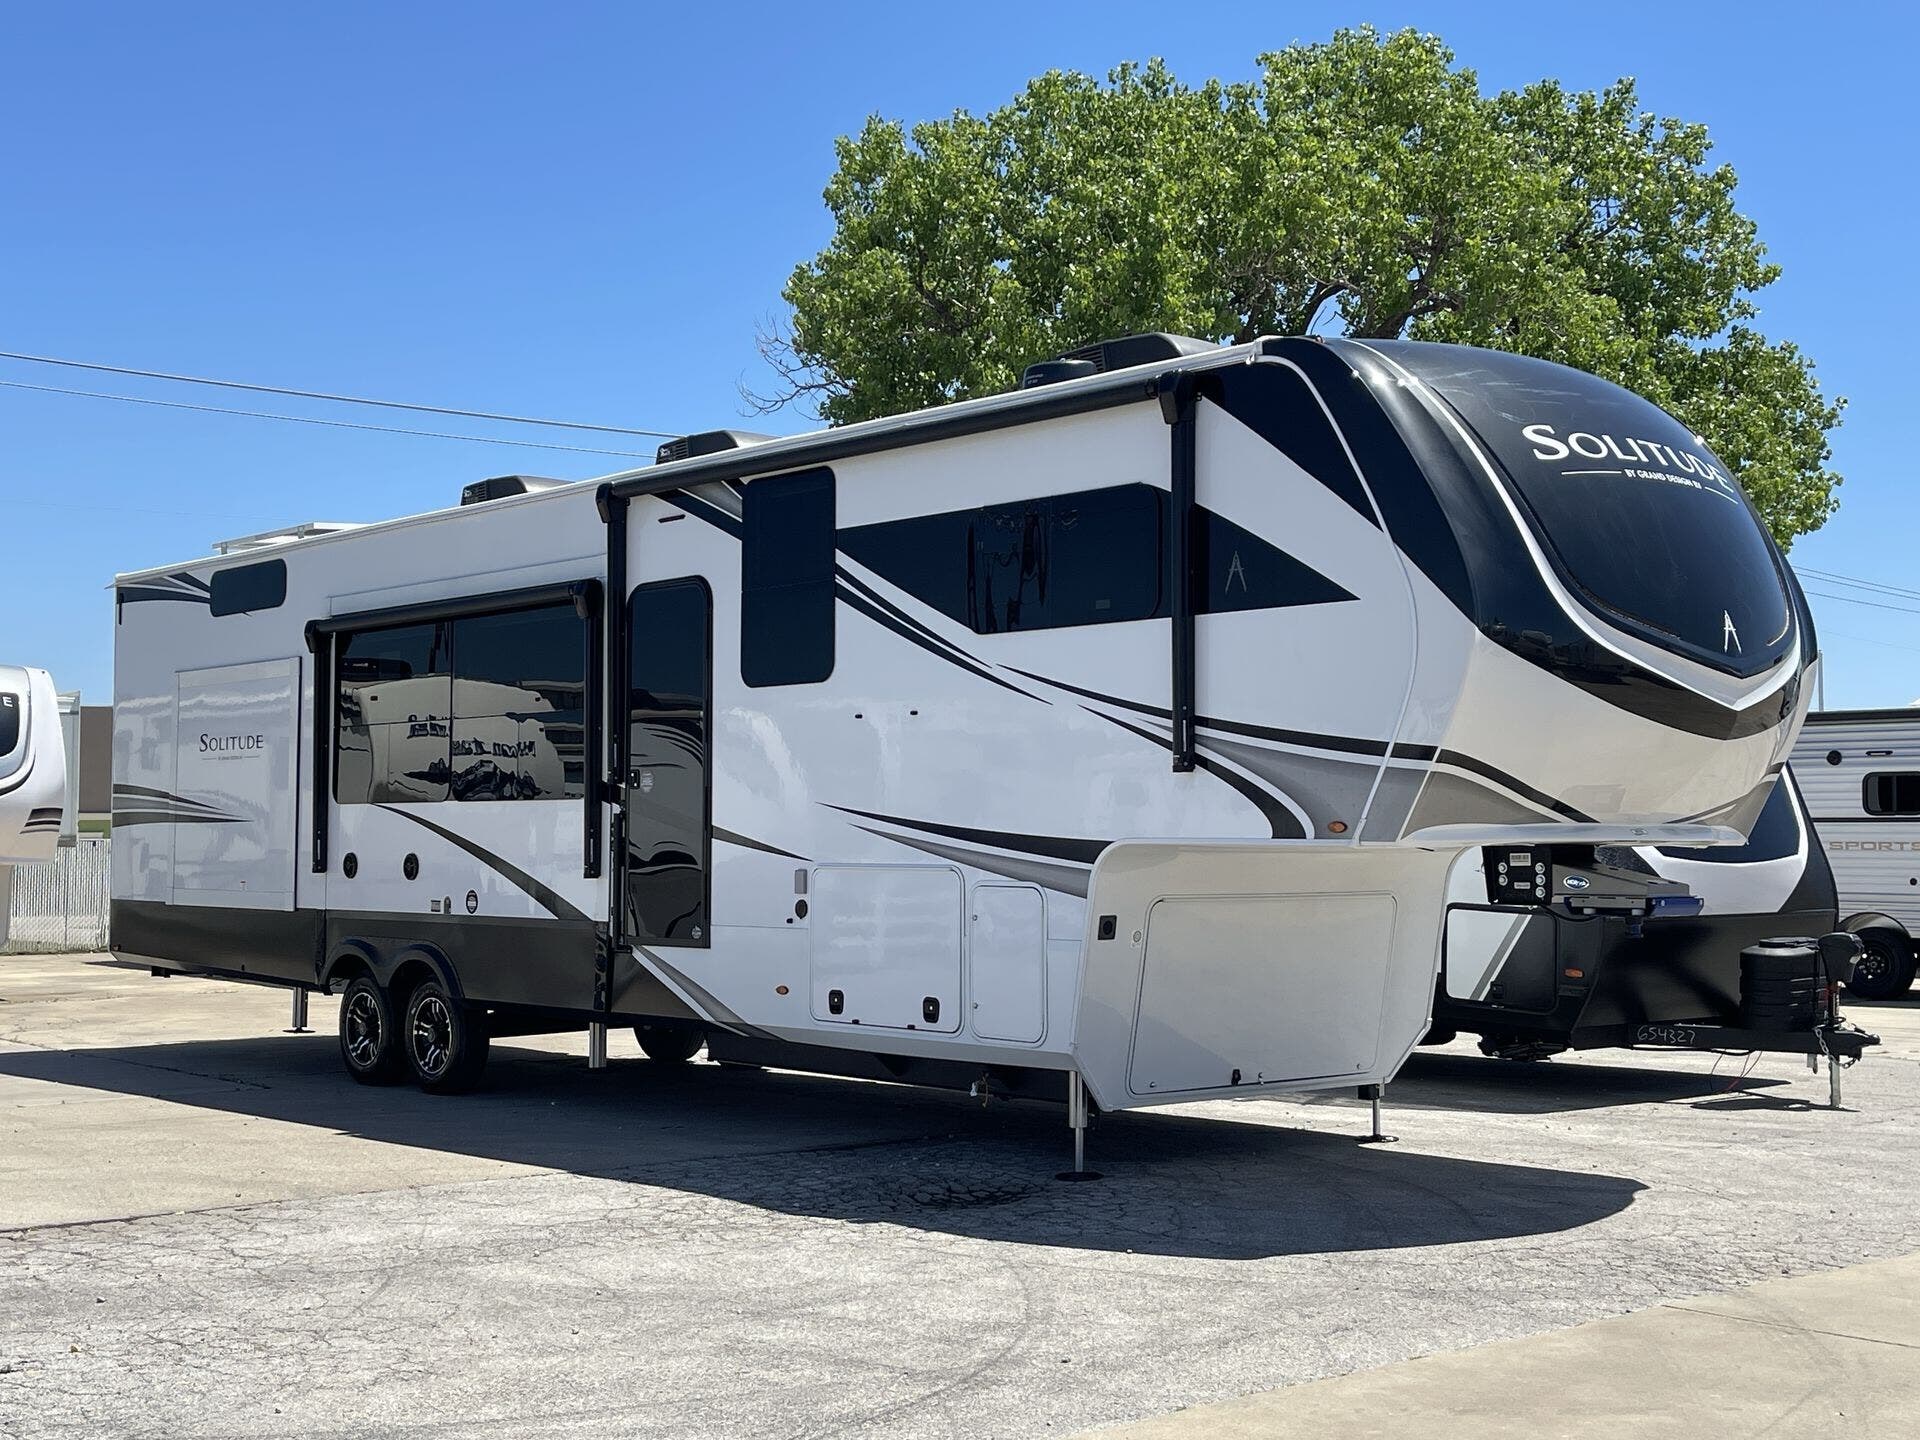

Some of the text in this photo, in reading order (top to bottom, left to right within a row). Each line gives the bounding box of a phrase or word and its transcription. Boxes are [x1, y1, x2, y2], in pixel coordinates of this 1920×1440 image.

[1521, 424, 1735, 493] SOLITUDE
[1624, 468, 1636, 478] BY
[1636, 469, 1667, 481] GRAND
[1665, 473, 1694, 487] DESIGN
[199, 733, 264, 753] SOLITUDE
[1637, 1024, 1696, 1045] 654327
